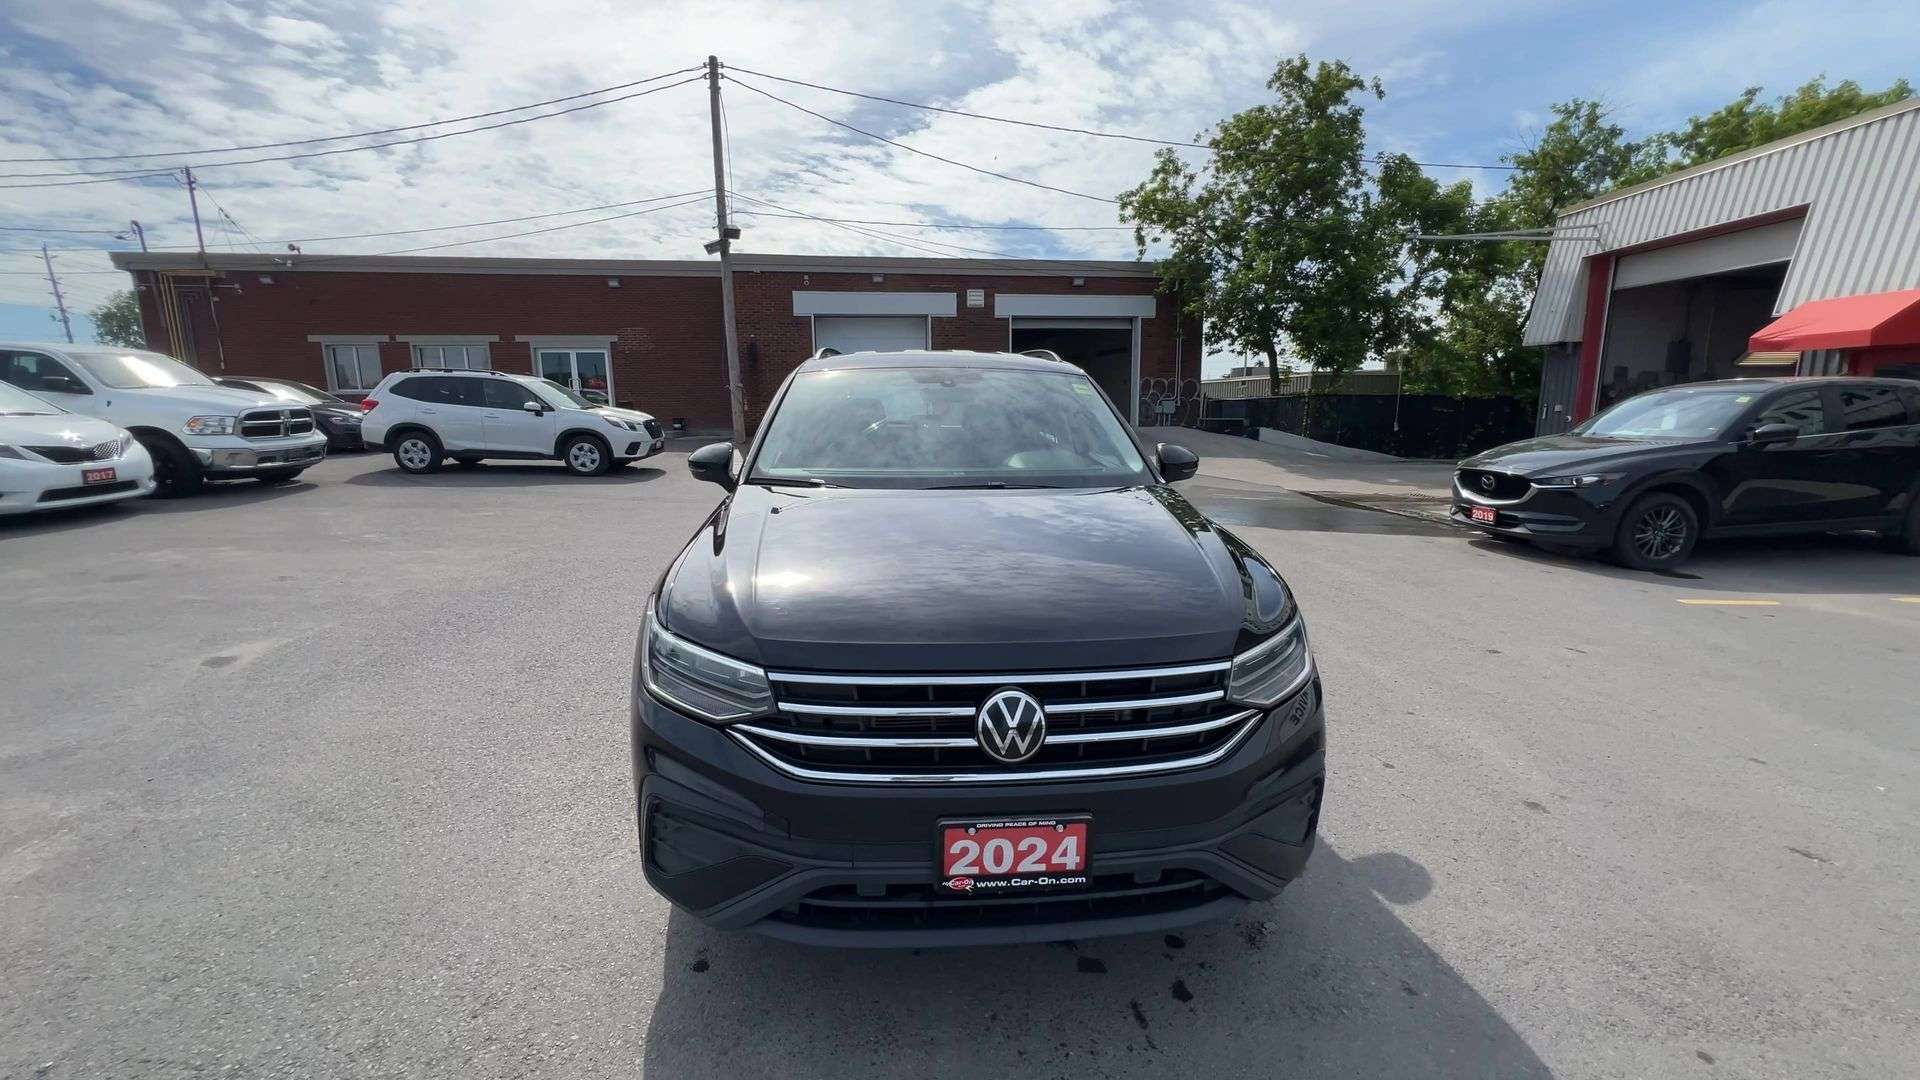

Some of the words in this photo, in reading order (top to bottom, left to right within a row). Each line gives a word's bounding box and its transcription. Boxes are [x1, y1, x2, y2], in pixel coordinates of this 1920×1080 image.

[86, 470, 113, 481] 2017
[1472, 509, 1494, 521] 2019
[978, 690, 1046, 762] VW
[949, 836, 1080, 875] 2024
[976, 877, 1086, 888] www.Car-On.com
